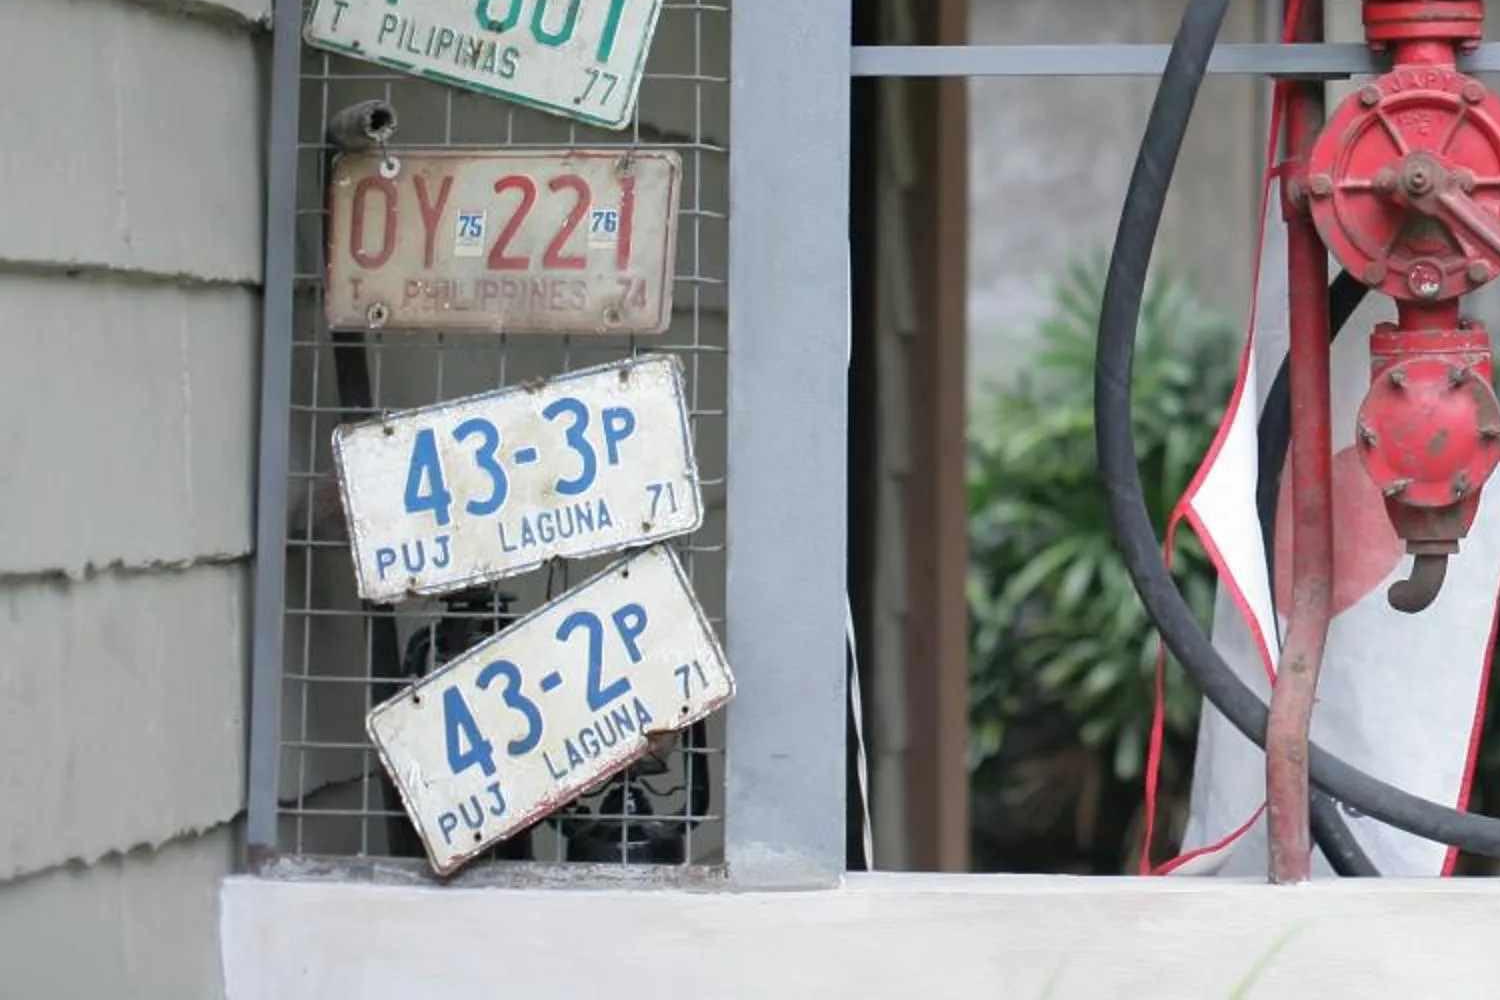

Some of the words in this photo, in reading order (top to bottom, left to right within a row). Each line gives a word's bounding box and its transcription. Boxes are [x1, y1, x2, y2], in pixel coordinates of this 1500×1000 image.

[332, 0, 348, 32] T
[378, 14, 521, 79] PILIPINAS
[580, 67, 618, 105] 77
[459, 214, 484, 238] 75
[487, 173, 636, 270] 221
[592, 211, 618, 233] 76
[376, 535, 452, 581] PUJ
[499, 498, 614, 553] LAGUNA
[645, 482, 679, 519] 71
[437, 782, 508, 846] PUJ
[543, 696, 654, 781] LAGUNA
[674, 660, 711, 701] 71
